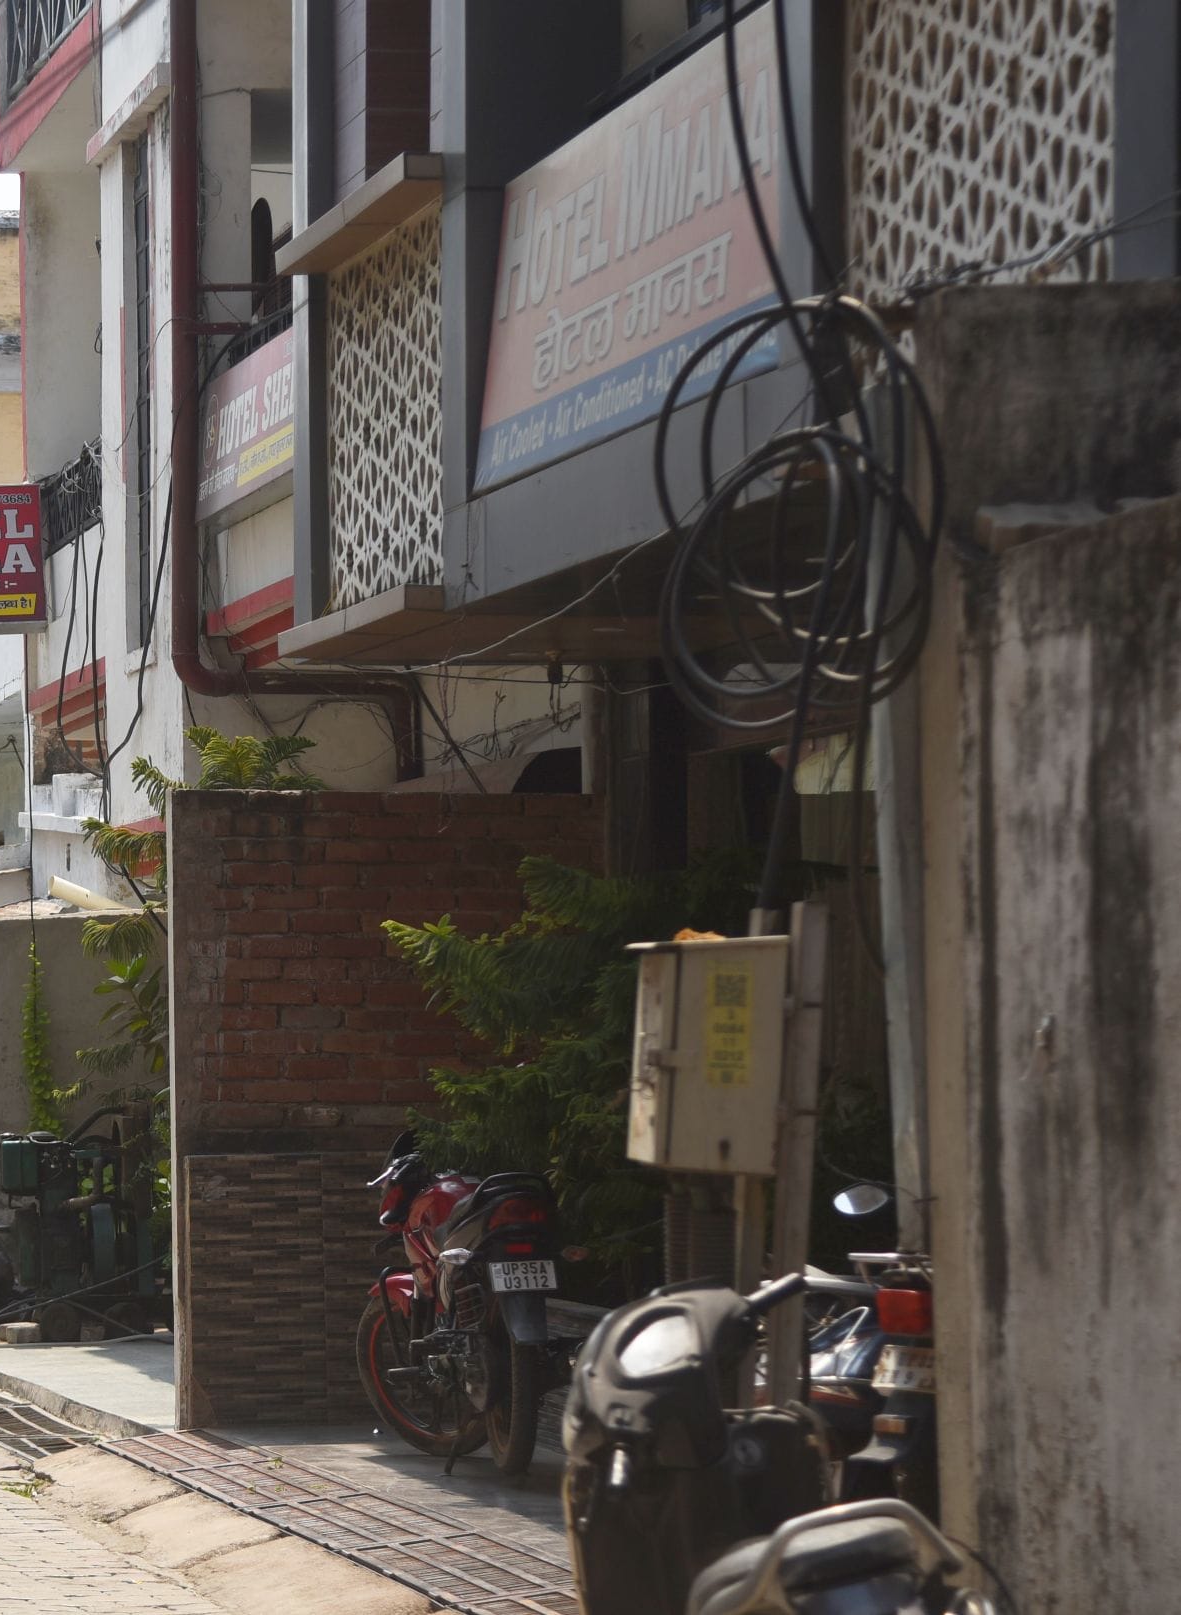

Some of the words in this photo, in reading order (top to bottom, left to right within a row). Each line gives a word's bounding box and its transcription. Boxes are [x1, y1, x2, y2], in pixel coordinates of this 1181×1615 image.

[497, 170, 610, 321] HOTEL
[531, 291, 618, 391] होटल
[623, 230, 733, 342] मानस
[216, 384, 259, 461] HOTEL
[491, 430, 507, 468] Air
[508, 408, 547, 461] Cooled
[553, 400, 572, 440] Air
[574, 362, 645, 432] Conditioned
[654, 348, 674, 397] AC
[501, 1262, 548, 1275] UP35A
[503, 1275, 549, 1289] U3112
